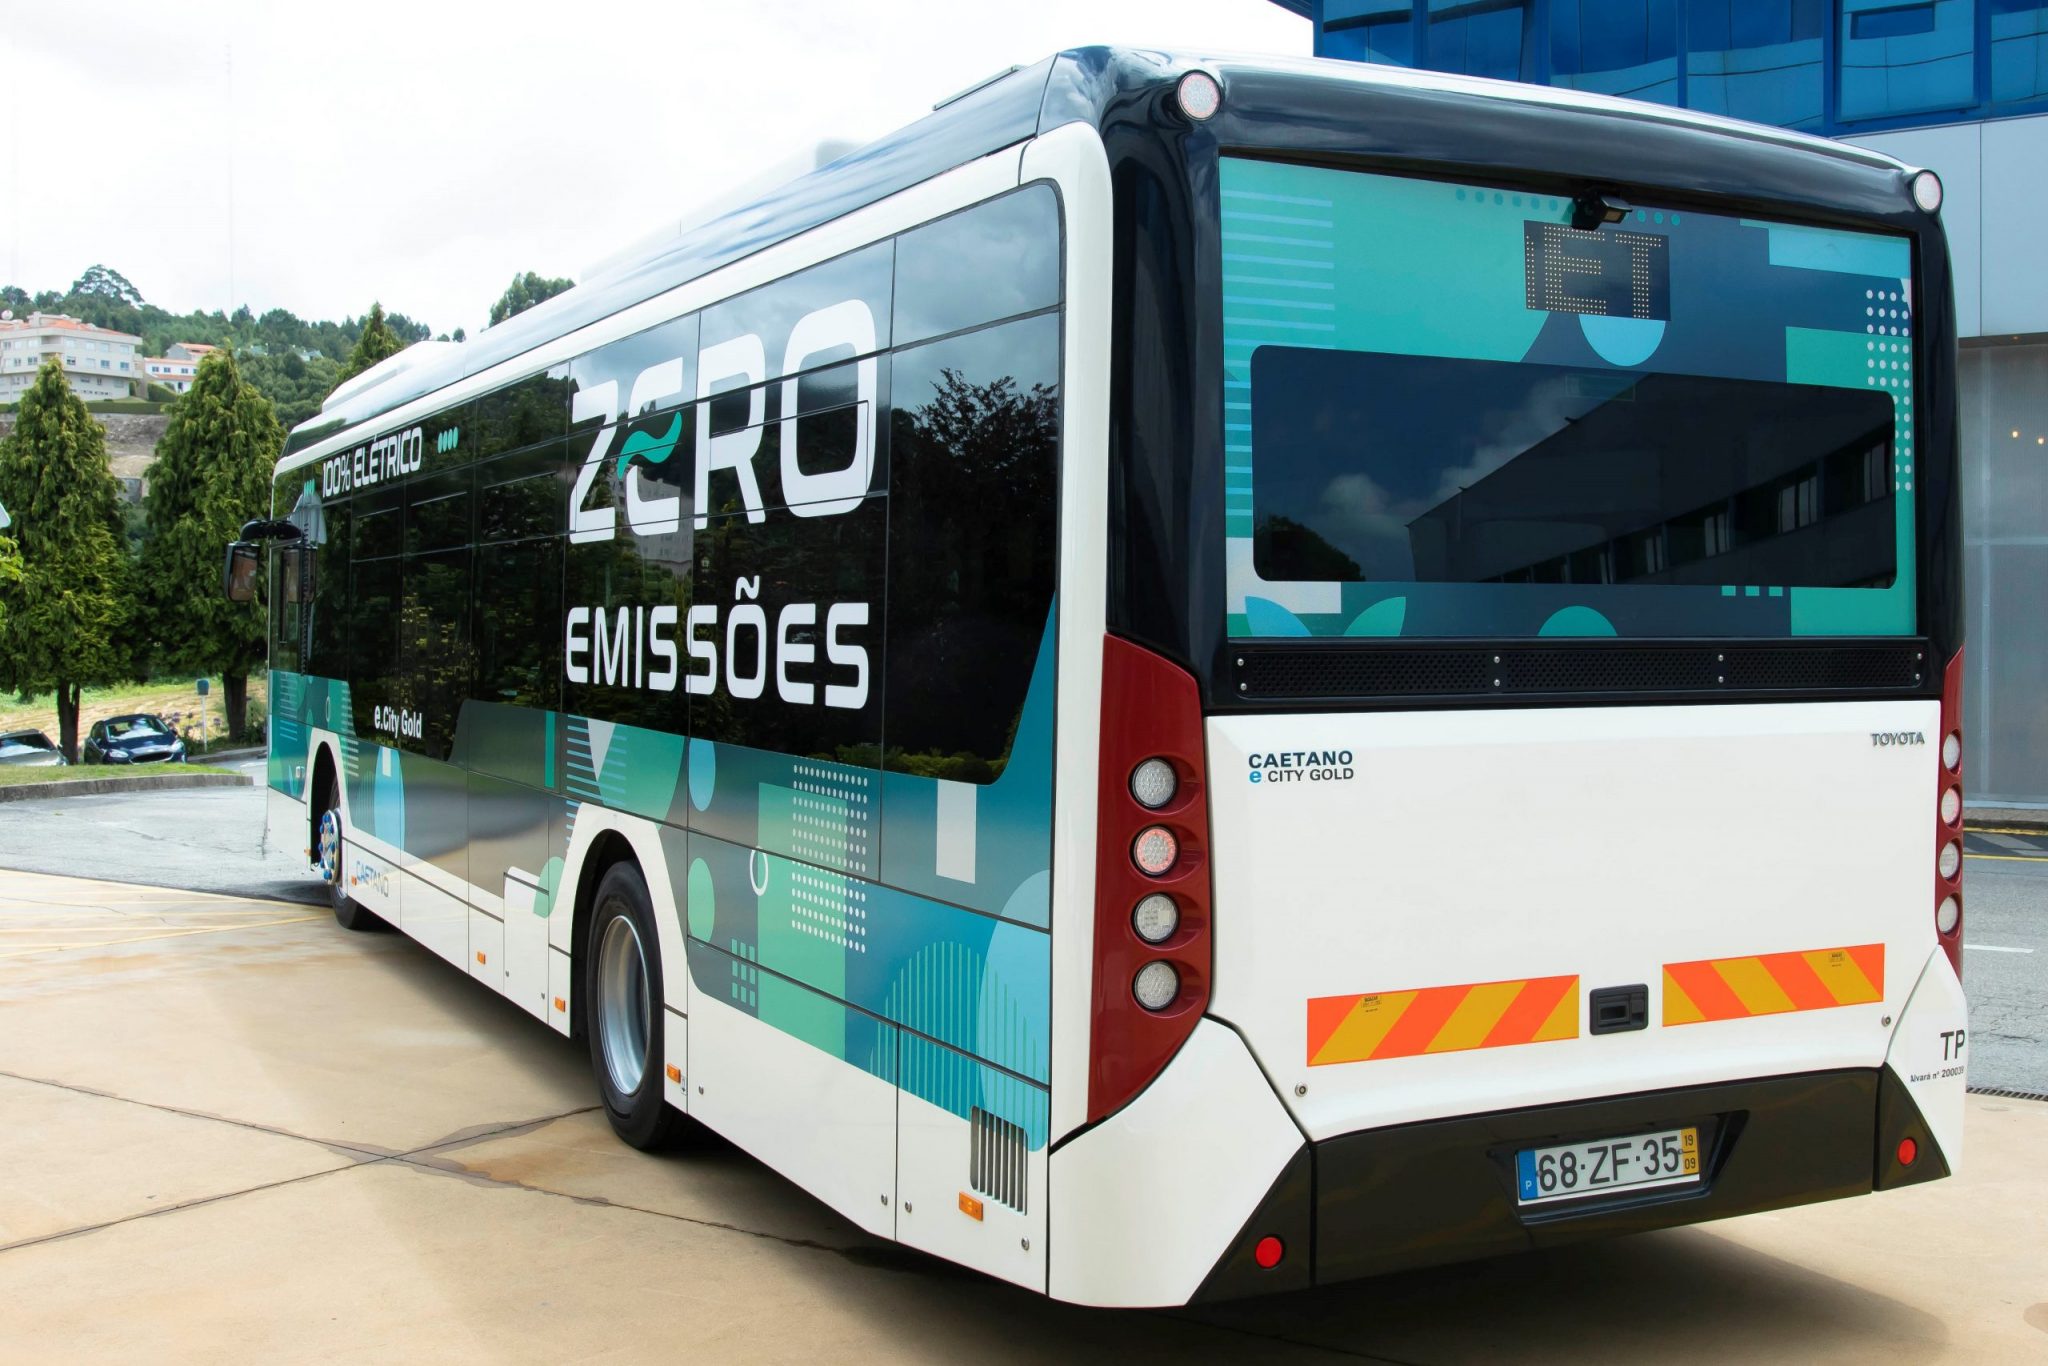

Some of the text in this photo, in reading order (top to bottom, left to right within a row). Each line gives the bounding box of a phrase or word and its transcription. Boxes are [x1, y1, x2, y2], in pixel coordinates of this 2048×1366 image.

[1526, 225, 1662, 320] ET
[569, 299, 877, 544] ZERO
[322, 426, 423, 499] 100% ELÉTRICO
[566, 575, 870, 710] EMISSÕES
[401, 709, 423, 739] Gold
[1871, 731, 1926, 747] TOYOTA
[1248, 750, 1353, 769] CAETANO
[1267, 769, 1305, 783] CITY
[1309, 767, 1354, 781] GOLD
[1940, 1029, 1965, 1061] TP
[1684, 1134, 1694, 1147] 19
[1684, 1157, 1697, 1170] 09
[1525, 1180, 1533, 1191] P
